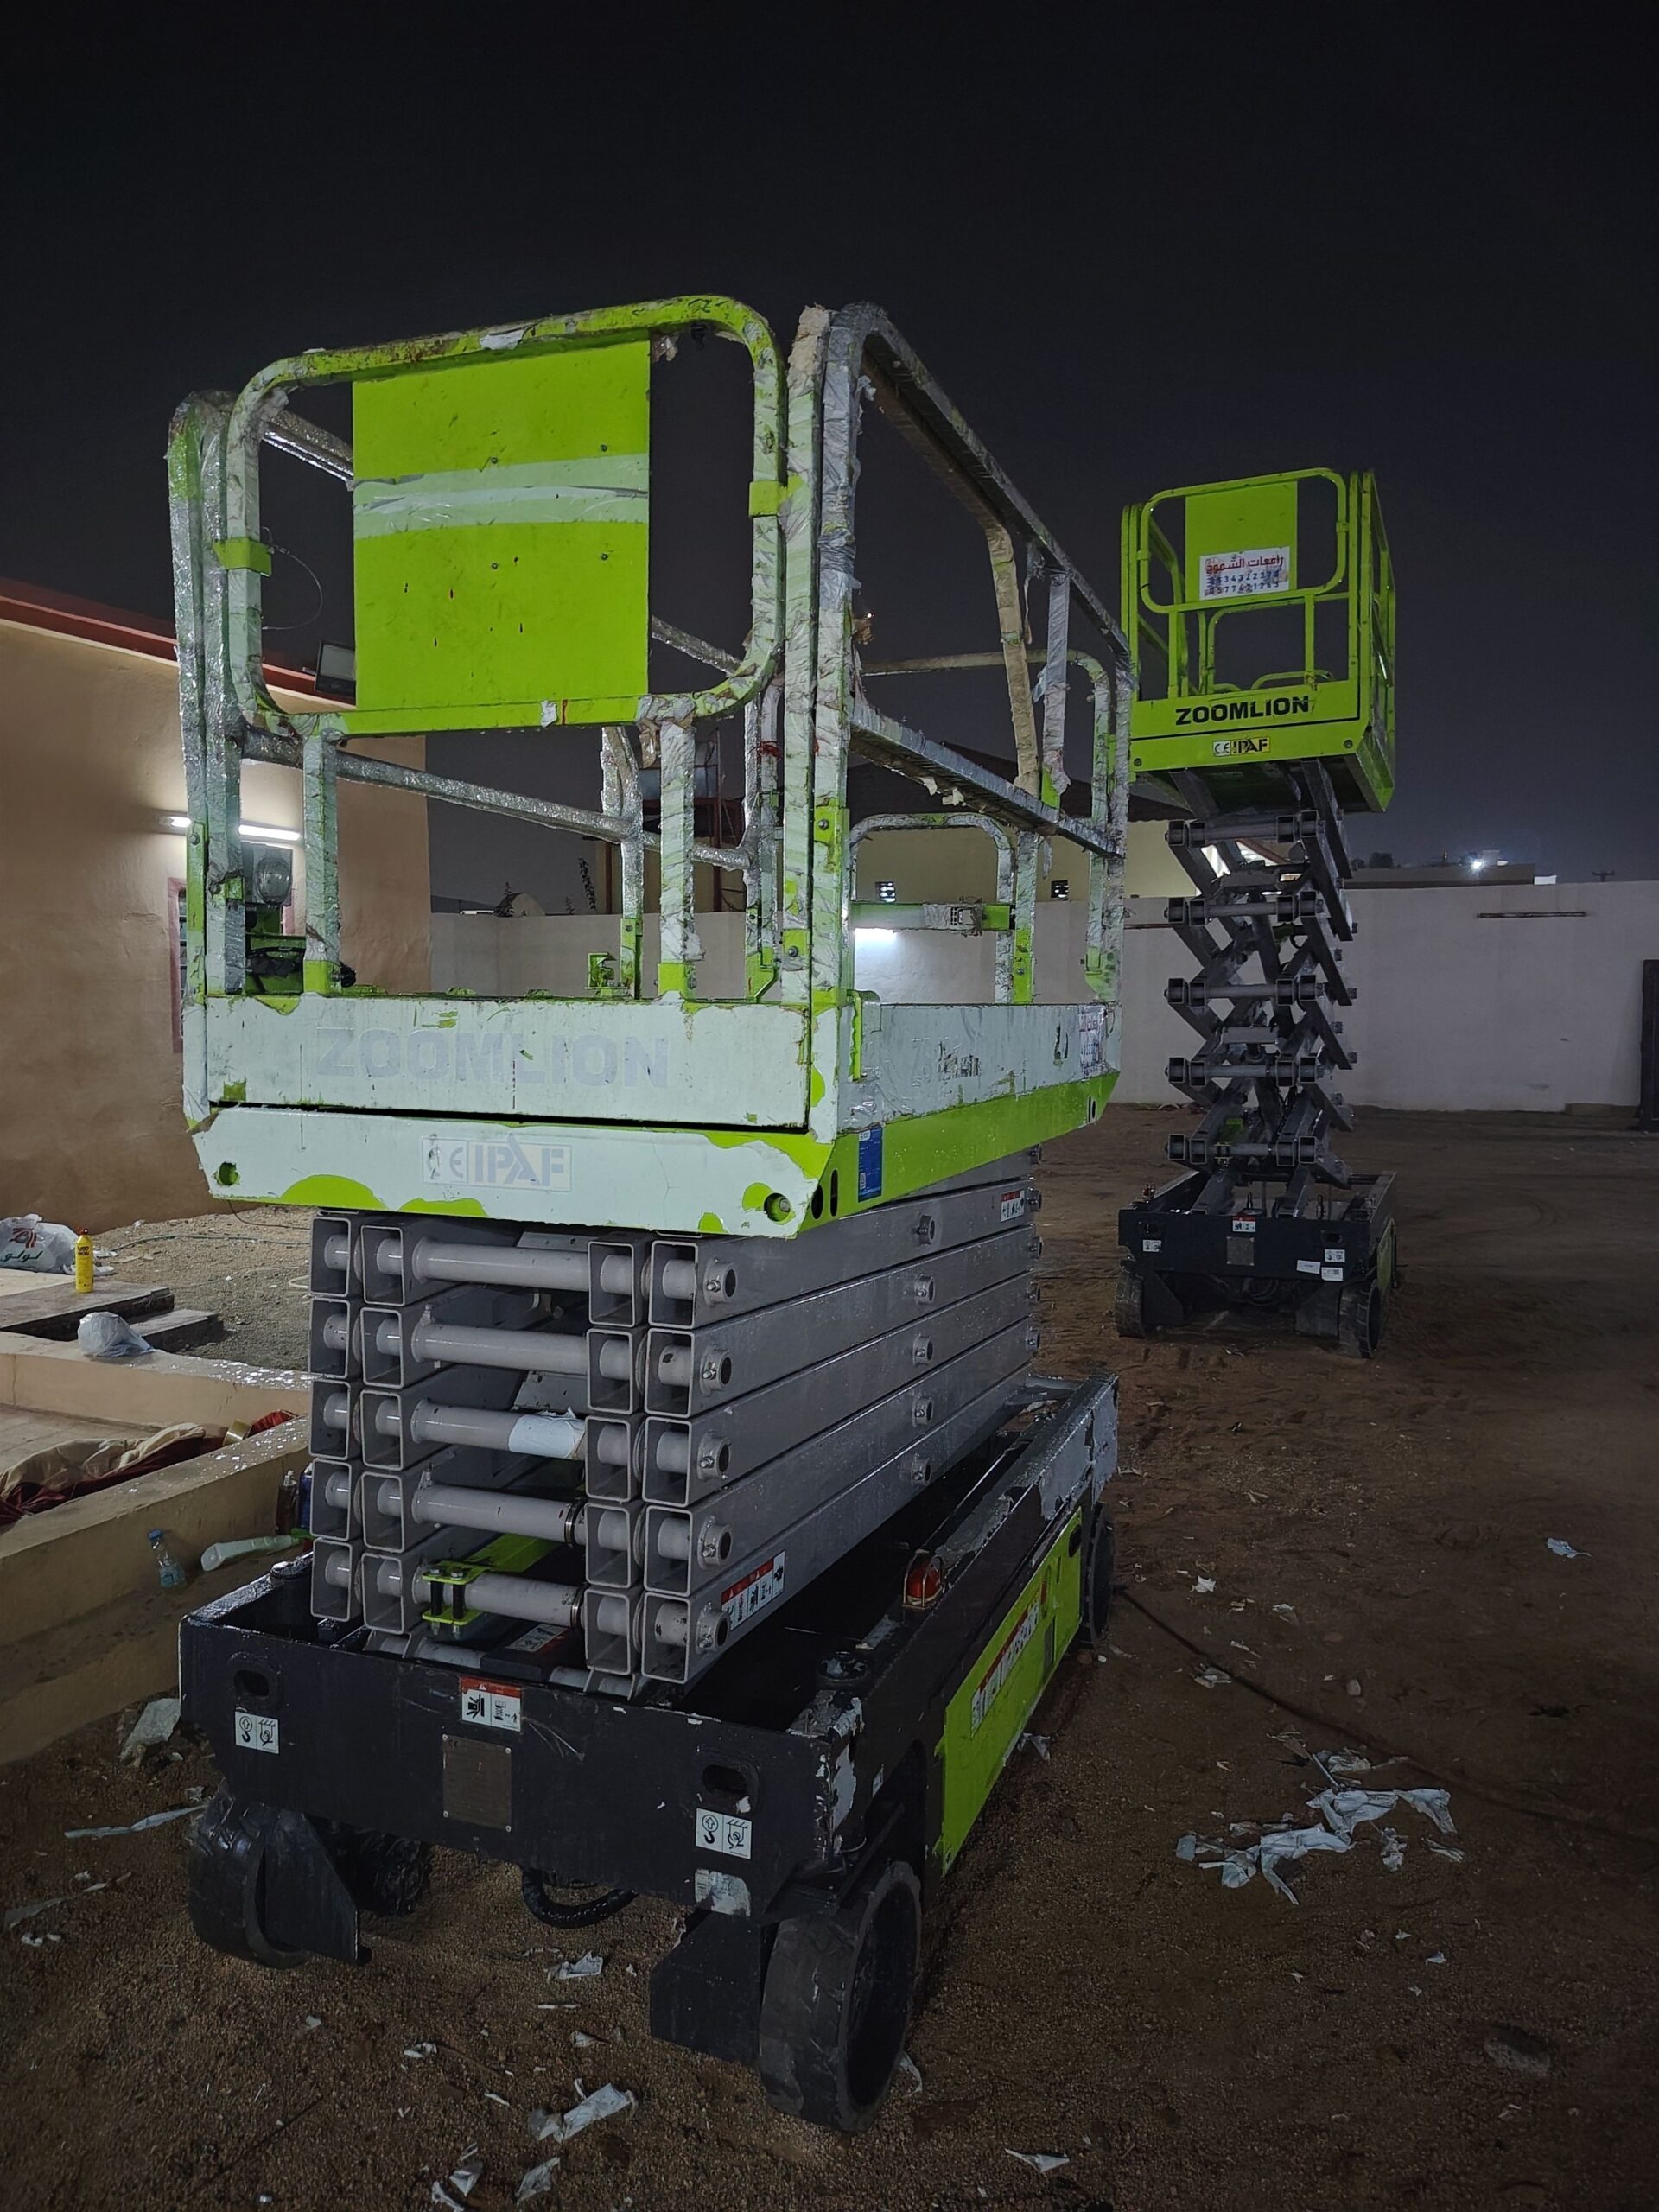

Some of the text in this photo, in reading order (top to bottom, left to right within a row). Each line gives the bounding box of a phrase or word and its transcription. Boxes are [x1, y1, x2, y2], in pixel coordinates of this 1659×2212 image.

[1248, 553, 1284, 568] رافعات
[1175, 695, 1310, 726] ZOOMLION
[1233, 737, 1268, 754] IPAF
[315, 1027, 670, 1090] ZOOMLION
[474, 1132, 565, 1187] IPAF
